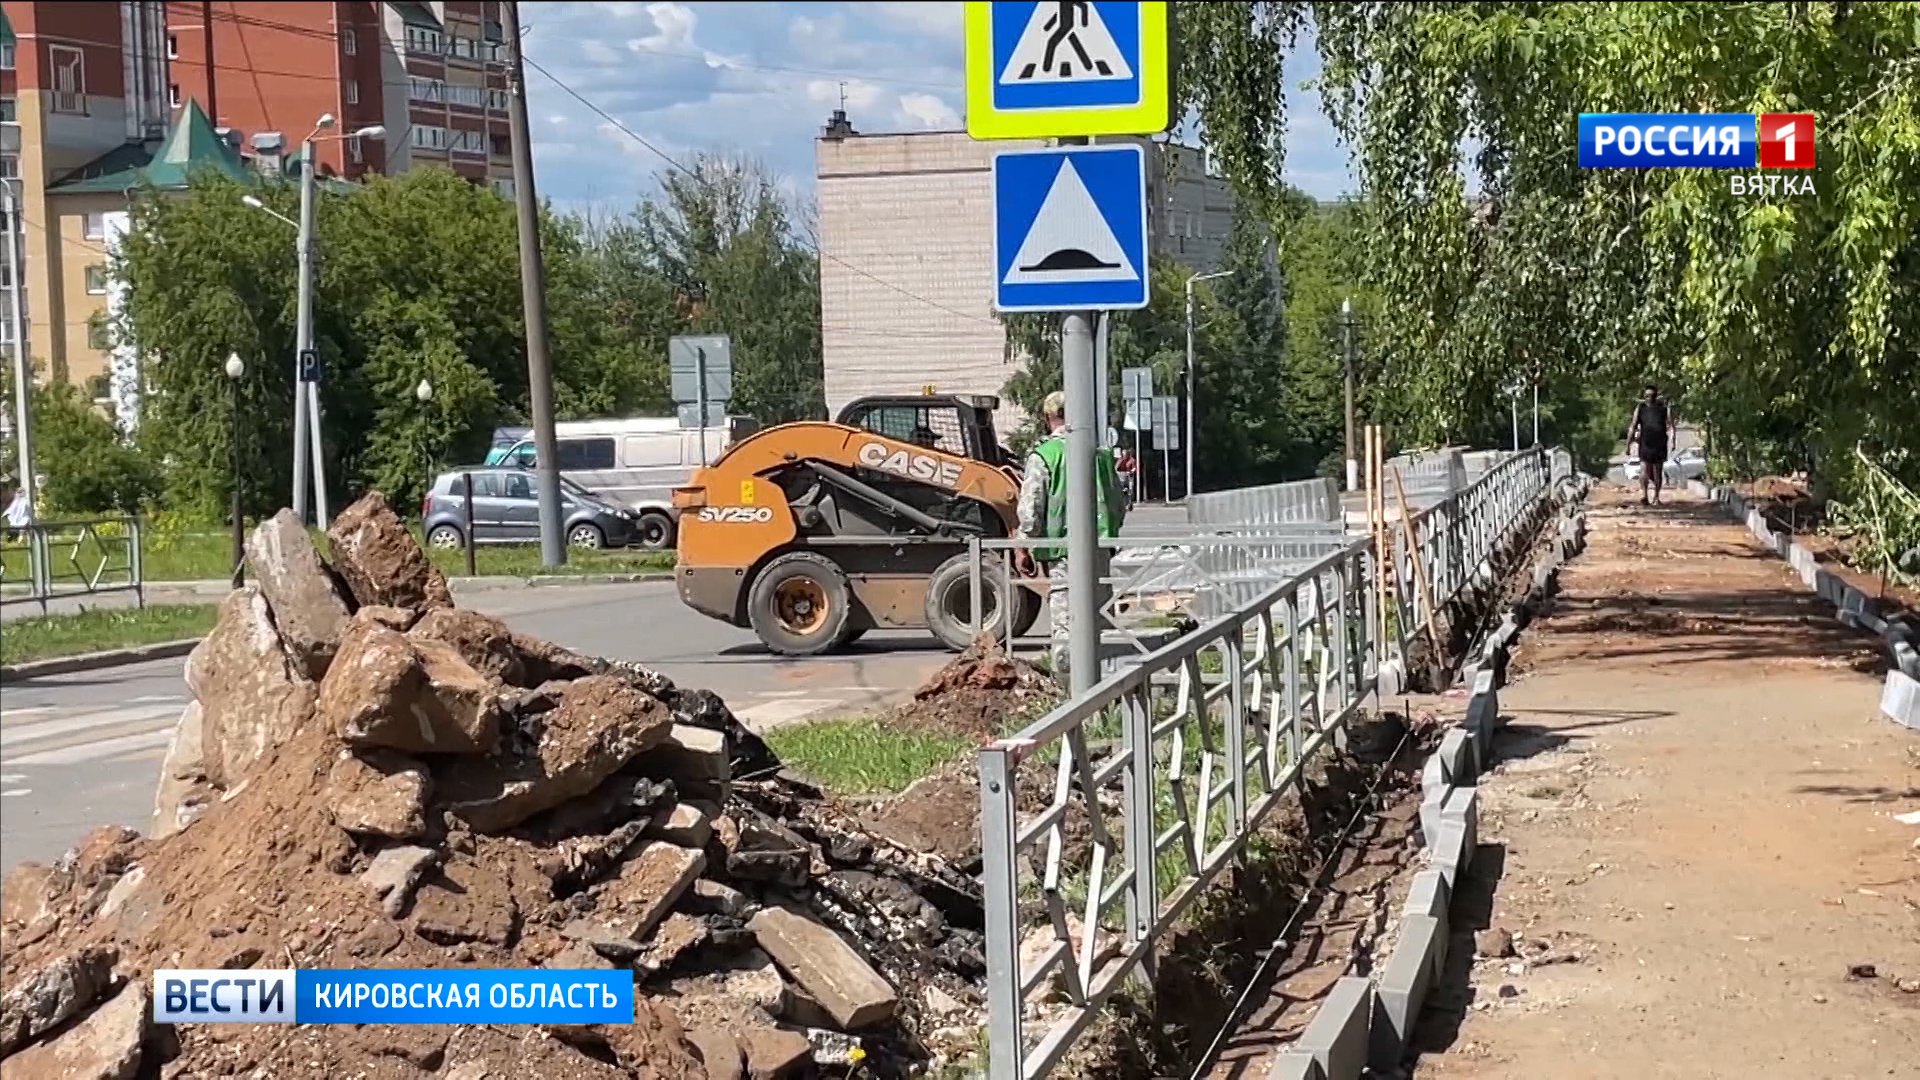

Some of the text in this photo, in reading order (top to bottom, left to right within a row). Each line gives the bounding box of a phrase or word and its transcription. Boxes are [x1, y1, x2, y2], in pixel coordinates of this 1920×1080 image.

[303, 353, 315, 378] P
[859, 442, 964, 488] CASE
[697, 506, 773, 523] SV250
